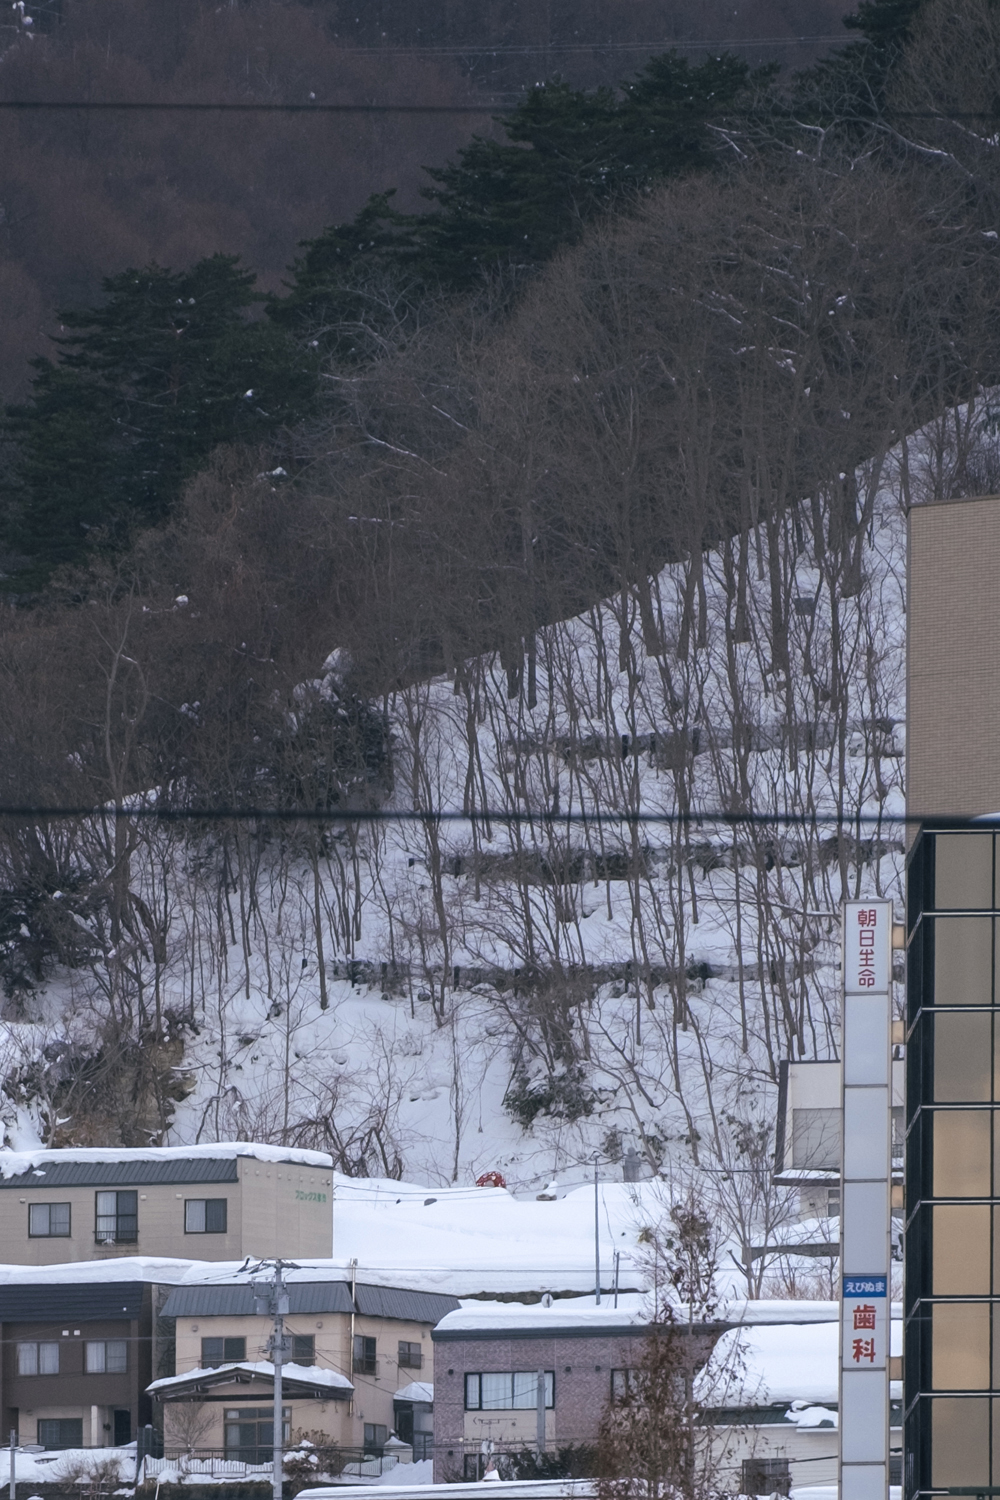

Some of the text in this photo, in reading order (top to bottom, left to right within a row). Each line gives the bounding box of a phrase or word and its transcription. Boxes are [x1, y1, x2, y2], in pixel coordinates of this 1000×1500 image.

[857, 909, 877, 988] 朝日生命
[852, 1304, 876, 1363] 歯科
